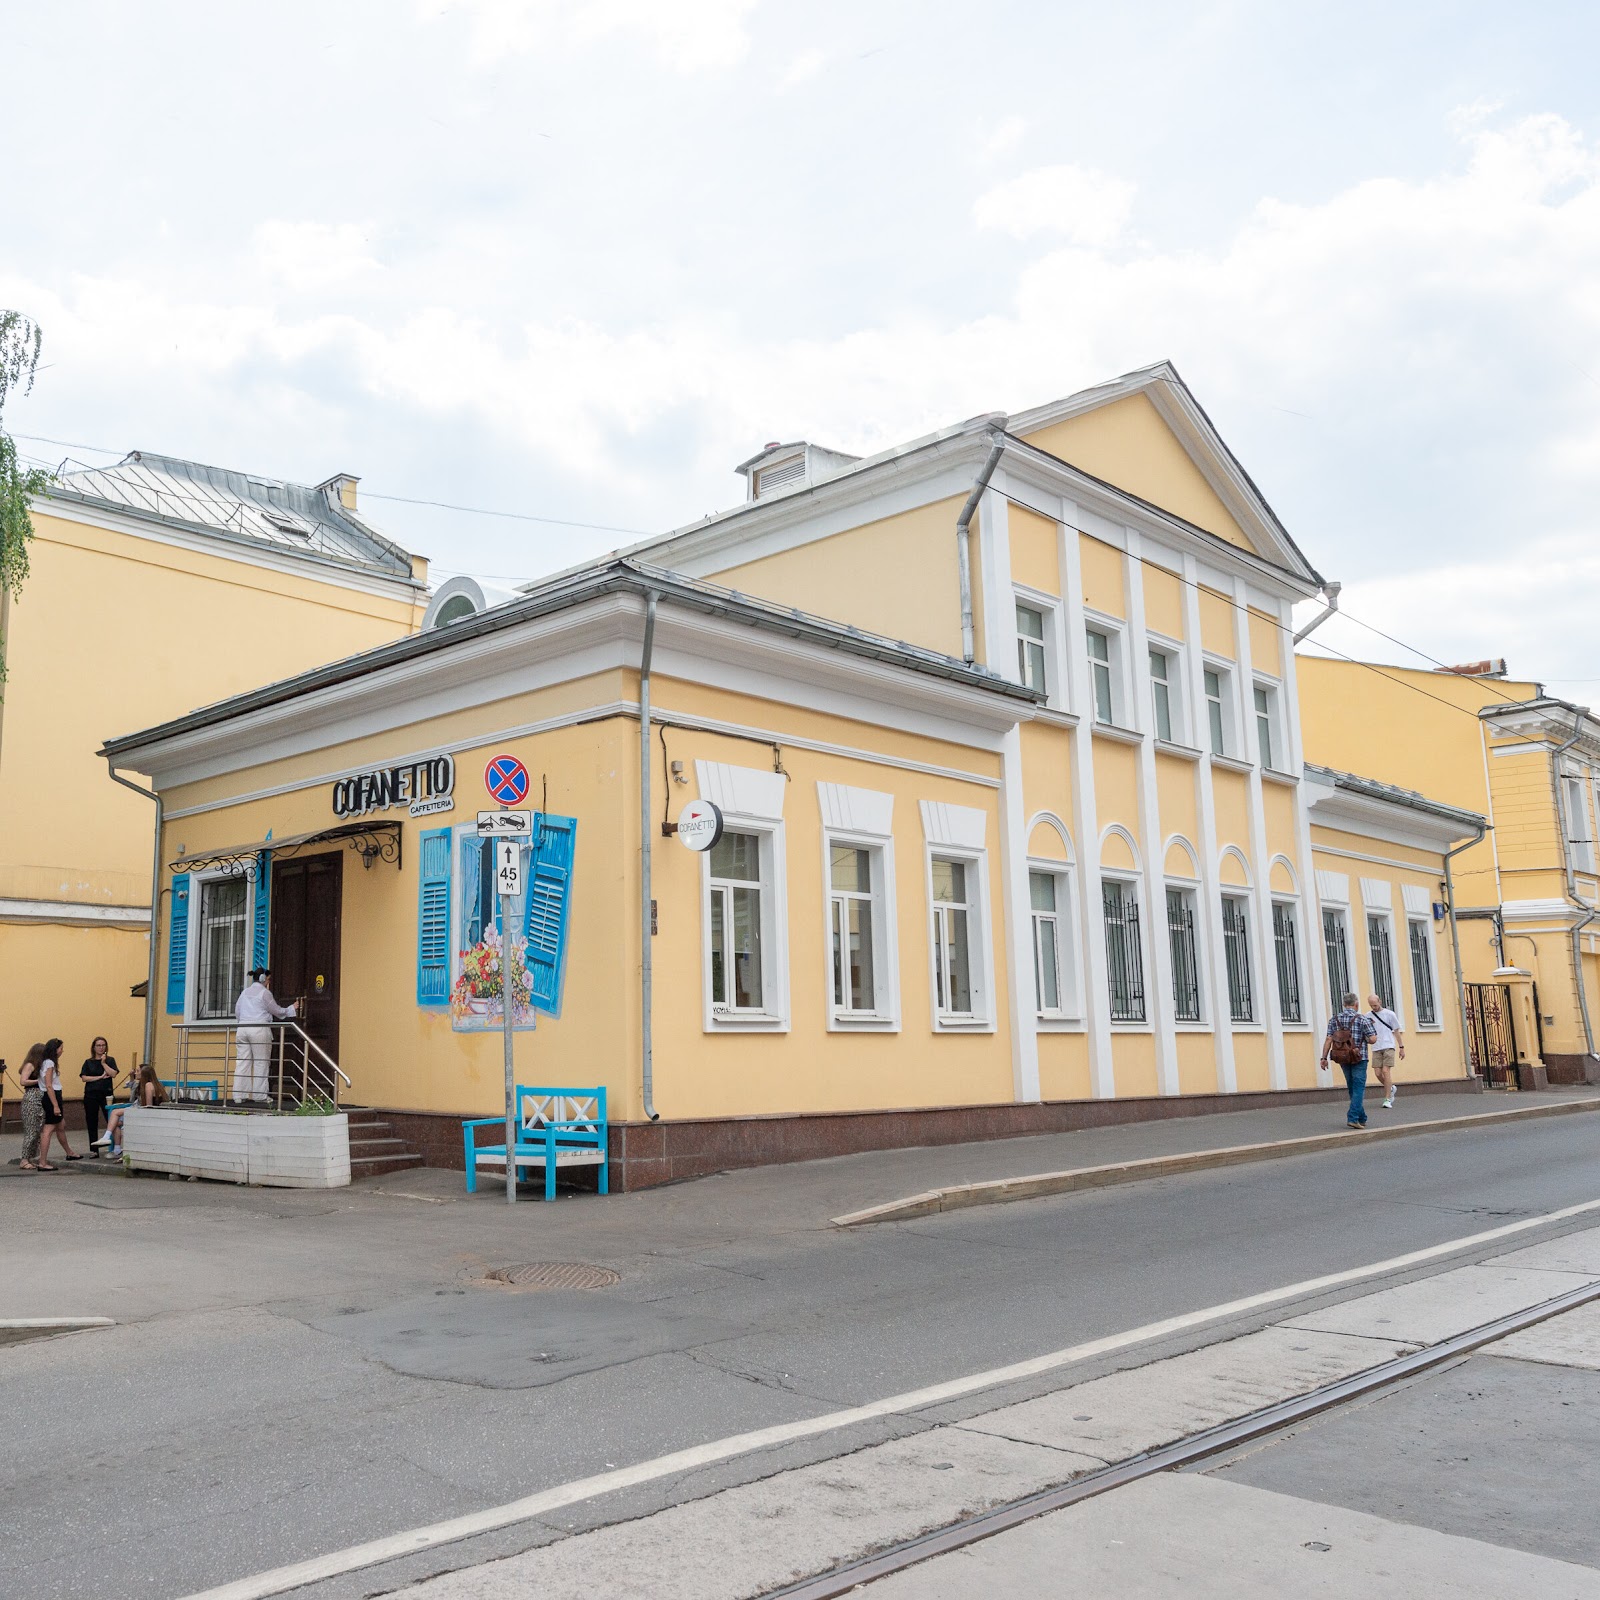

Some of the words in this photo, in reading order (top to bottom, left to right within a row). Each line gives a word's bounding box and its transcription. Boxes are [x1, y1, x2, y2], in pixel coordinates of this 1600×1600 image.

[333, 755, 453, 818] COFANETTO
[410, 799, 452, 814] CAFFETTERIA
[499, 866, 517, 880] 45
